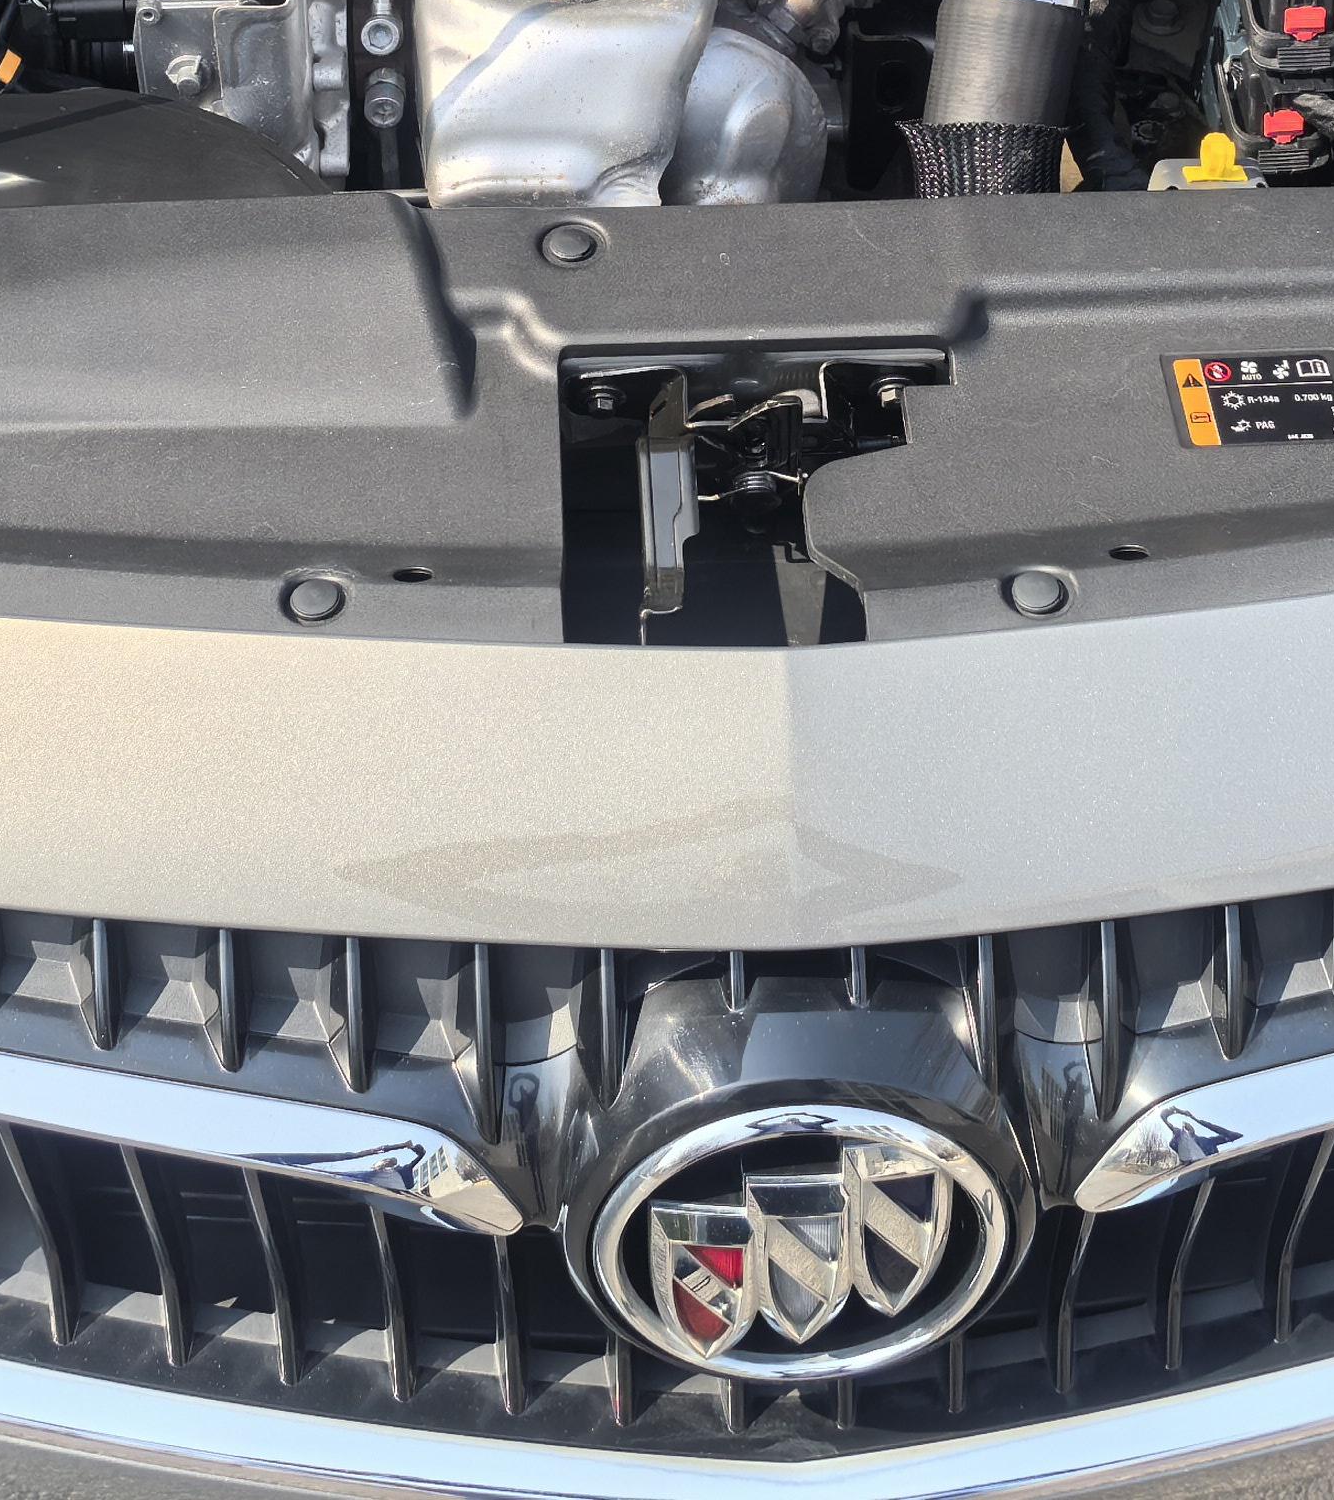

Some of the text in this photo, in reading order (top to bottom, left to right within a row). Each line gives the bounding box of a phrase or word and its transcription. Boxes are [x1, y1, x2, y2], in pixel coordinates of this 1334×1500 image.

[1241, 373, 1263, 381] AUTO
[1247, 395, 1280, 404] R-134a
[1294, 392, 1334, 402] 0.700 kg
[1255, 420, 1276, 430] PAG
